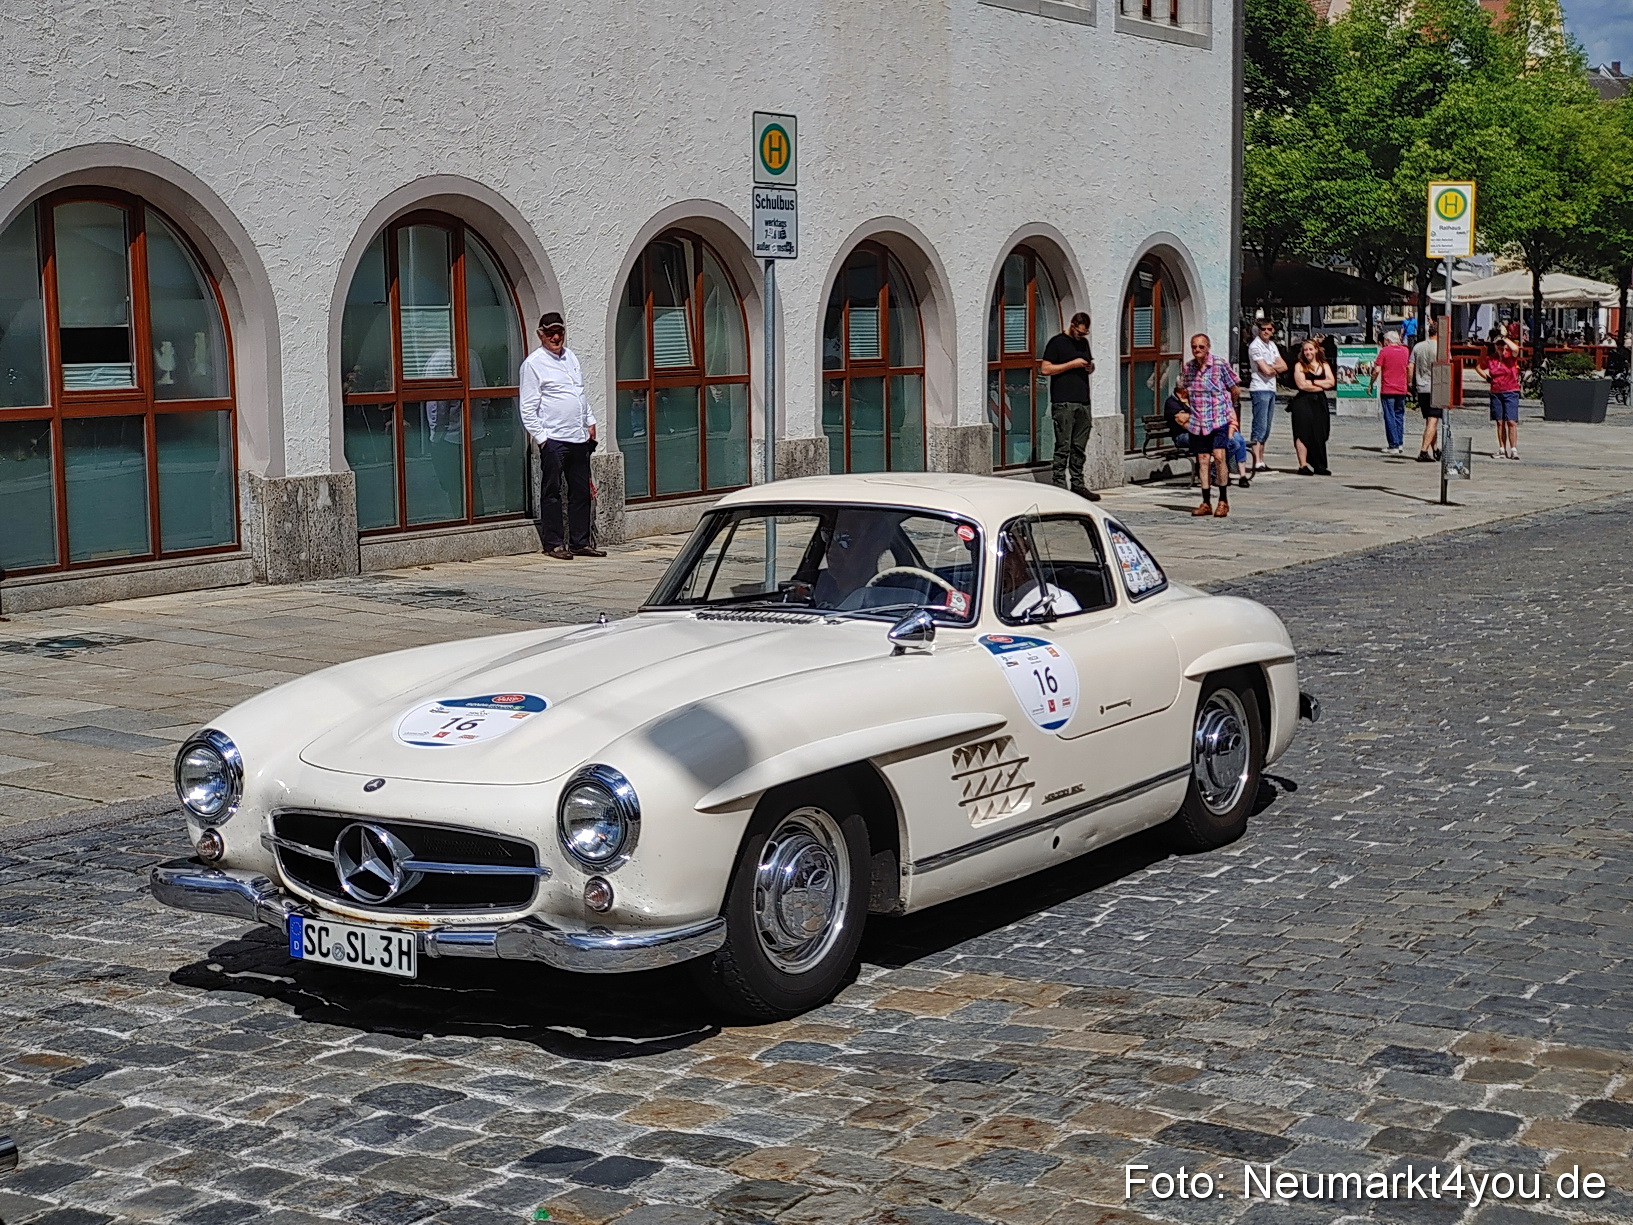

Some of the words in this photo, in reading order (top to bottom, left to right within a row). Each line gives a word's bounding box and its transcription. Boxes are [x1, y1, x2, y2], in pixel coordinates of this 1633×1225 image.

[768, 134, 783, 165] H
[755, 193, 795, 211] Schulbus
[1444, 195, 1458, 214] H
[764, 218, 787, 229] werktags
[1033, 666, 1058, 696] 16
[440, 717, 486, 731] 16
[293, 940, 300, 951] D
[304, 923, 331, 959] SC
